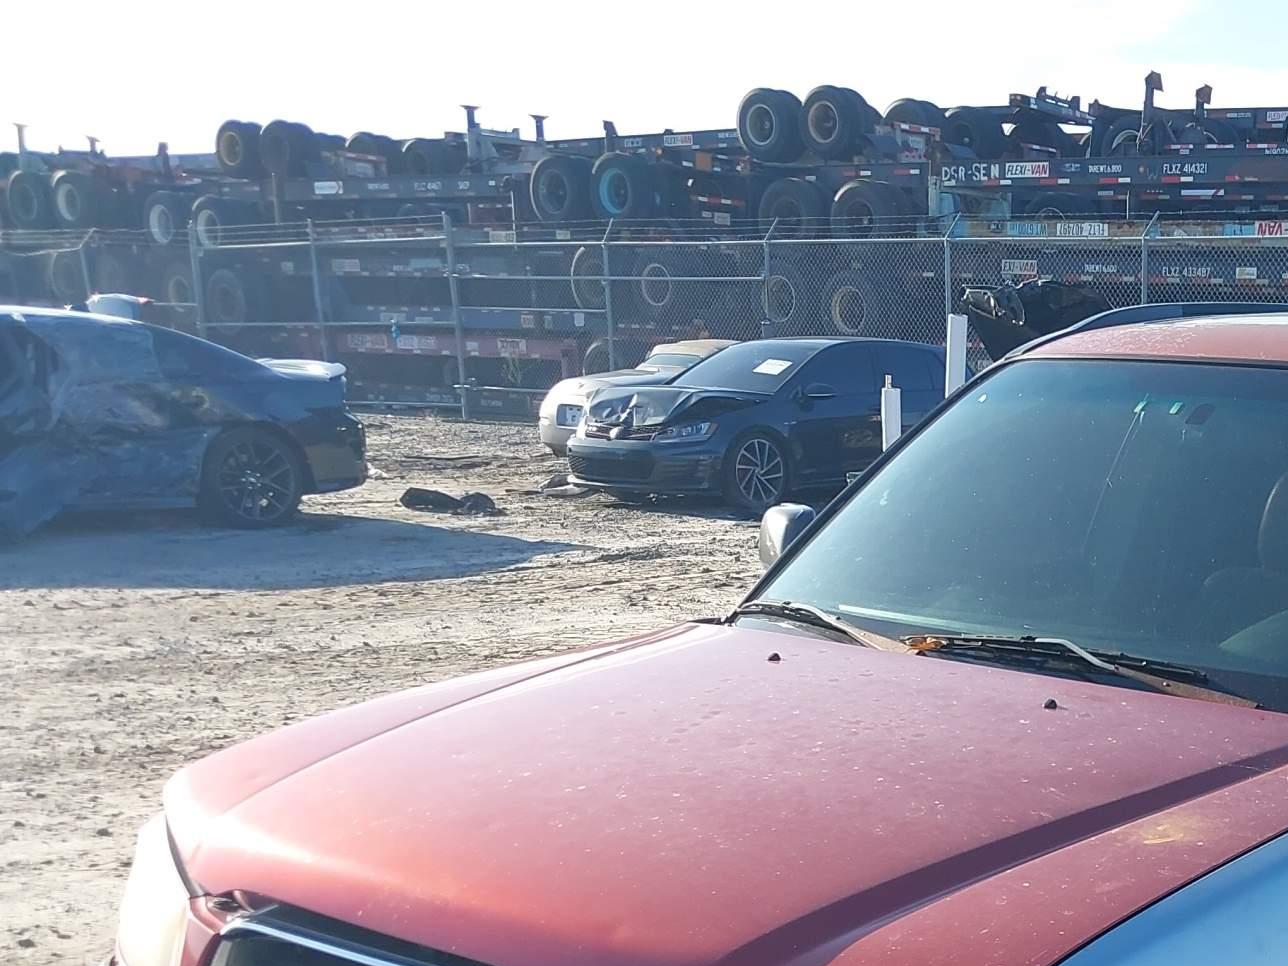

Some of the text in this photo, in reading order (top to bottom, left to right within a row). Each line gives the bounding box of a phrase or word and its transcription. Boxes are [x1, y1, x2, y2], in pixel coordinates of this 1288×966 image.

[1005, 162, 1049, 177] FLEXI-VAN
[1162, 163, 1208, 174] FLXZ 414321
